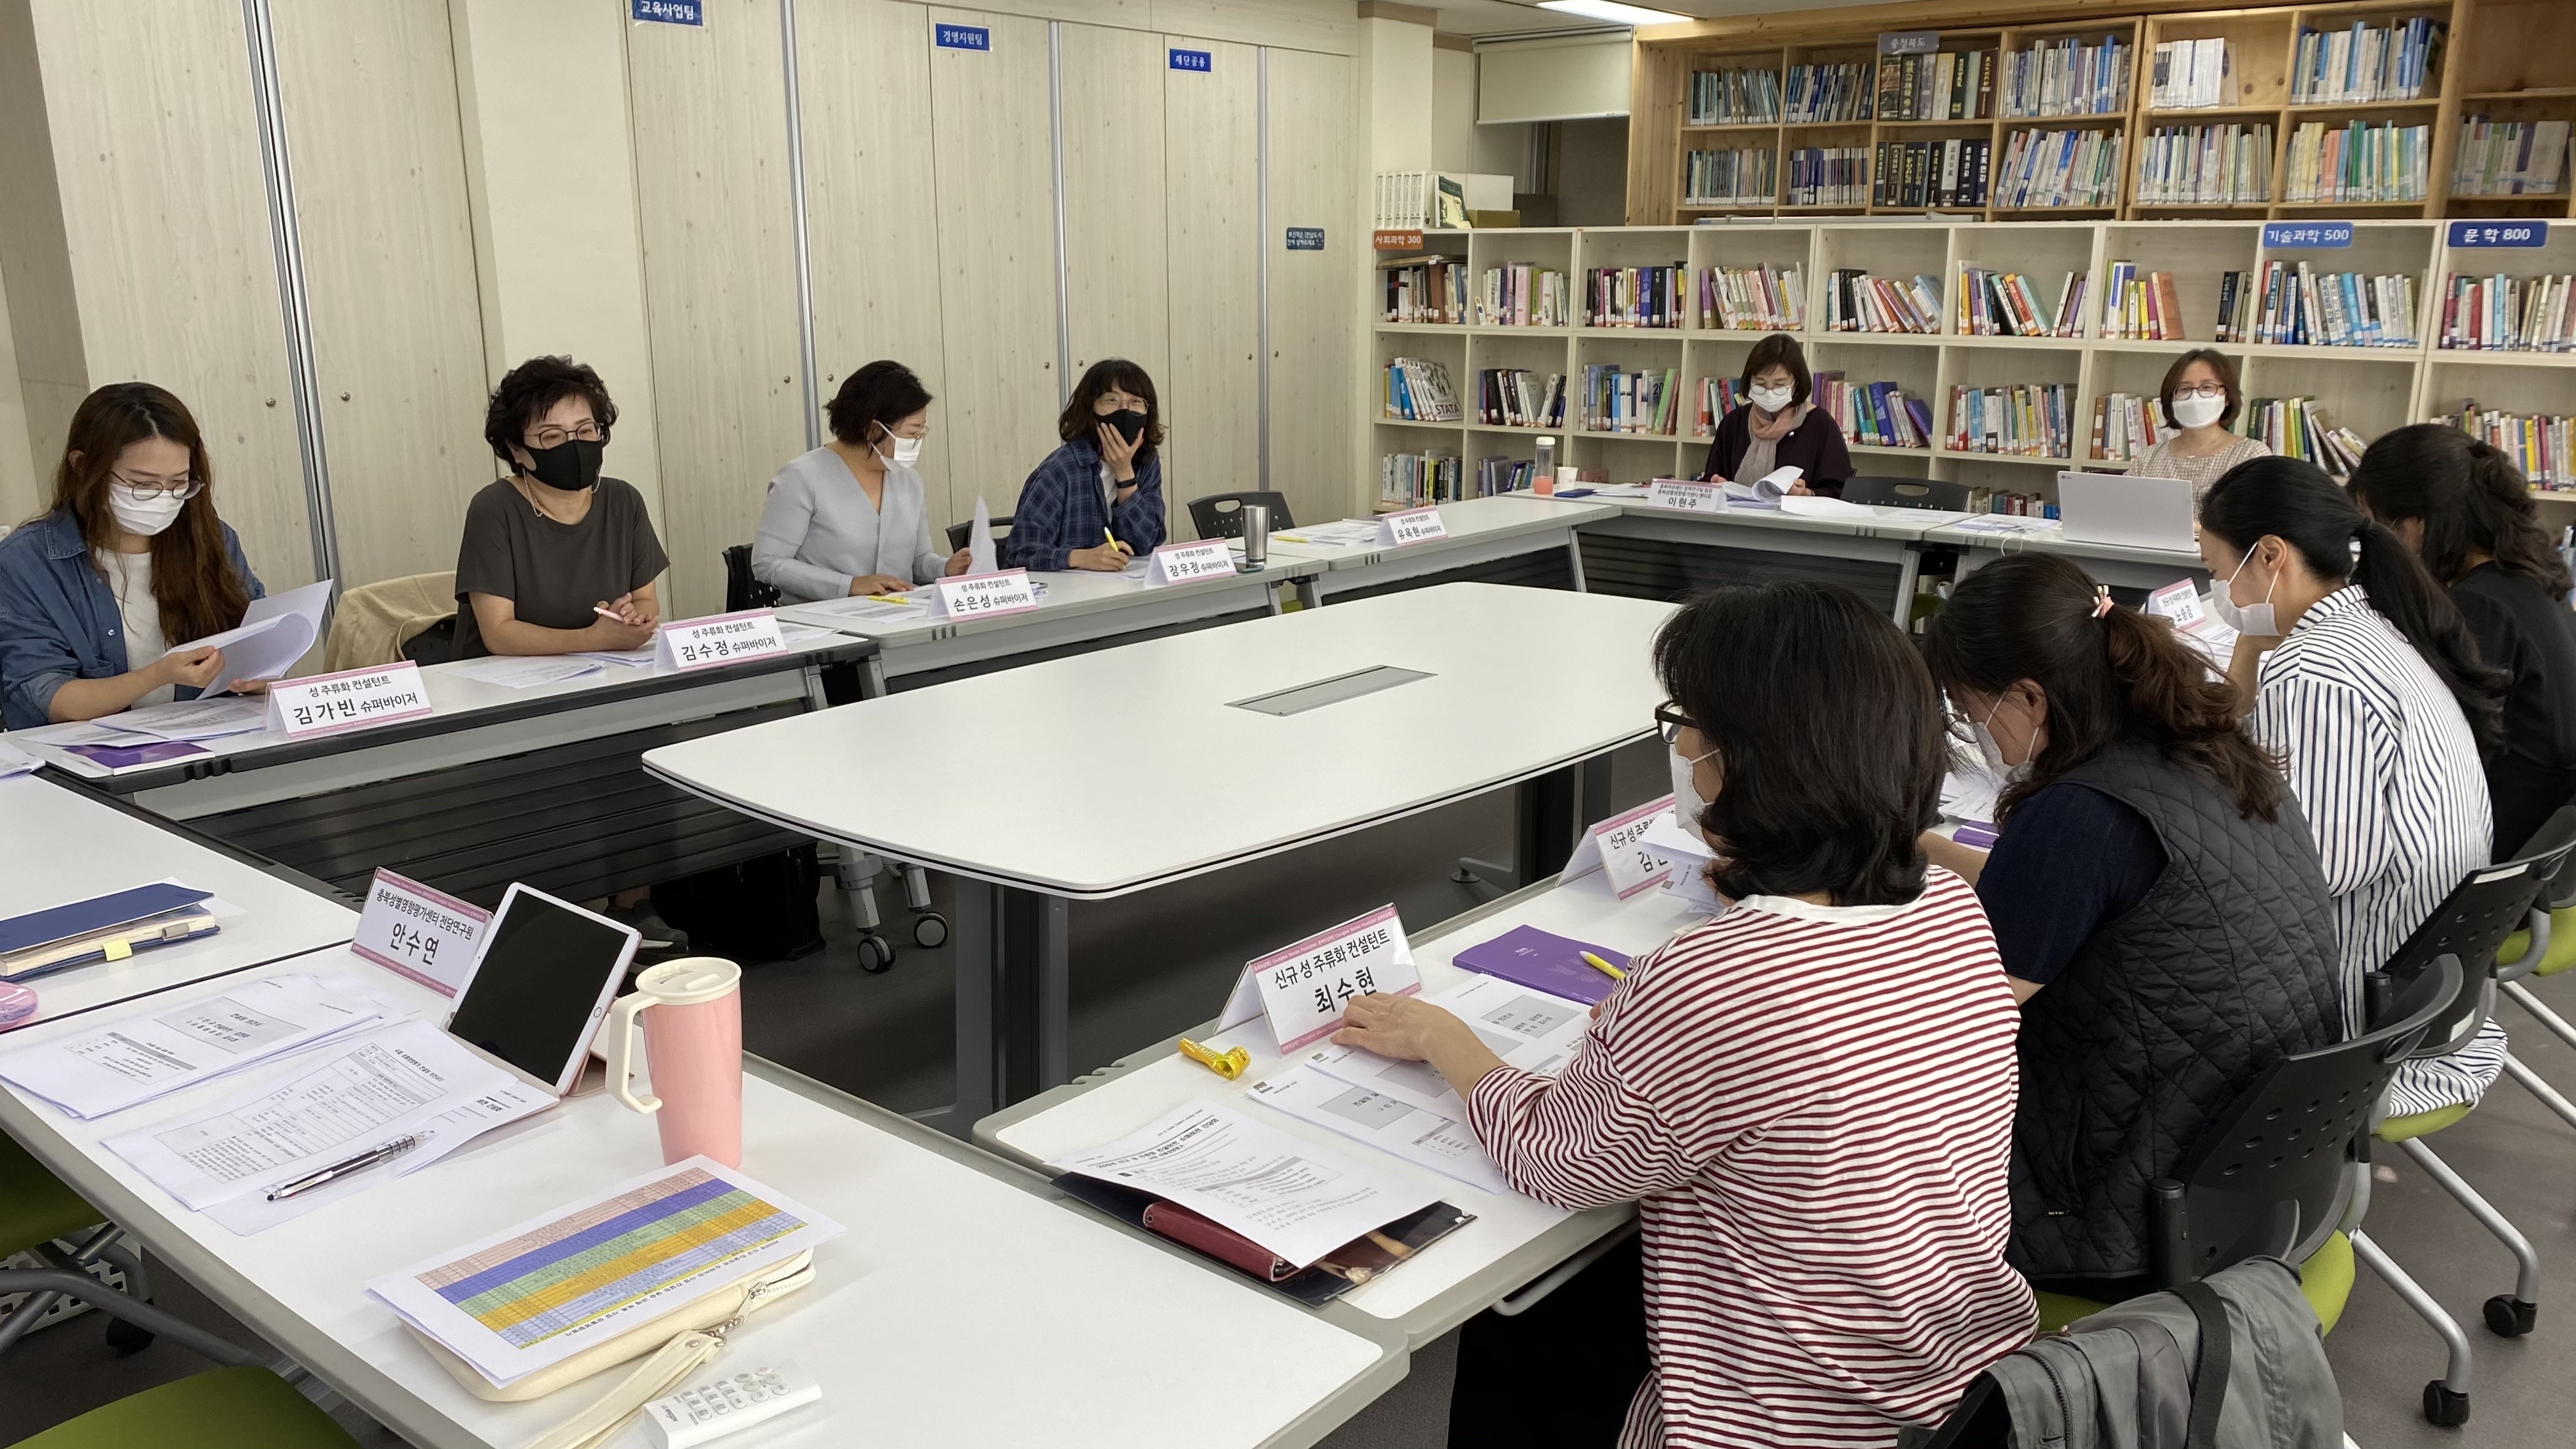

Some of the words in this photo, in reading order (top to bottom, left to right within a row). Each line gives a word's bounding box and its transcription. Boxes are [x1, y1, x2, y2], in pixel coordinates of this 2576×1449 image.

[641, 0, 694, 20] 교육사업팀
[943, 30, 983, 45] 경영지원팀
[1891, 37, 1926, 49] 충청북도
[1176, 54, 1206, 68] 재단공용
[1375, 235, 1406, 245] 사회과학
[1407, 235, 1421, 244] 300
[2268, 229, 2321, 244] 기술과학
[2324, 229, 2350, 240] 500
[2503, 228, 2531, 240] 800
[1435, 404, 1460, 415] STATA
[1181, 550, 1195, 558] 주류화
[1195, 548, 1215, 556] 컨설턴트
[1201, 559, 1230, 572] 슈퍼바이저
[961, 584, 968, 592] 성
[969, 581, 987, 591] 주류화
[987, 578, 1011, 590] 컨설턴트
[993, 592, 1029, 606] 슈퍼바이저
[692, 629, 701, 638] 성
[702, 625, 724, 637] 주류화
[724, 621, 756, 633] 컨설턴트
[732, 636, 777, 653] 슈퍼바이저
[309, 687, 319, 698] 성
[321, 682, 351, 696] 주류화
[352, 675, 392, 691] 컨설턴트
[360, 691, 418, 713] 슈퍼바이저
[1610, 831, 1627, 850] 신규
[1627, 829, 1636, 843] 성
[377, 888, 440, 926] 충북성별영향평가센터
[439, 915, 475, 940] 전담연구원
[1275, 965, 1298, 990] 신규
[1300, 959, 1313, 979] 성
[1314, 945, 1347, 972] 주류화
[1347, 928, 1390, 959] 컨설턴트
